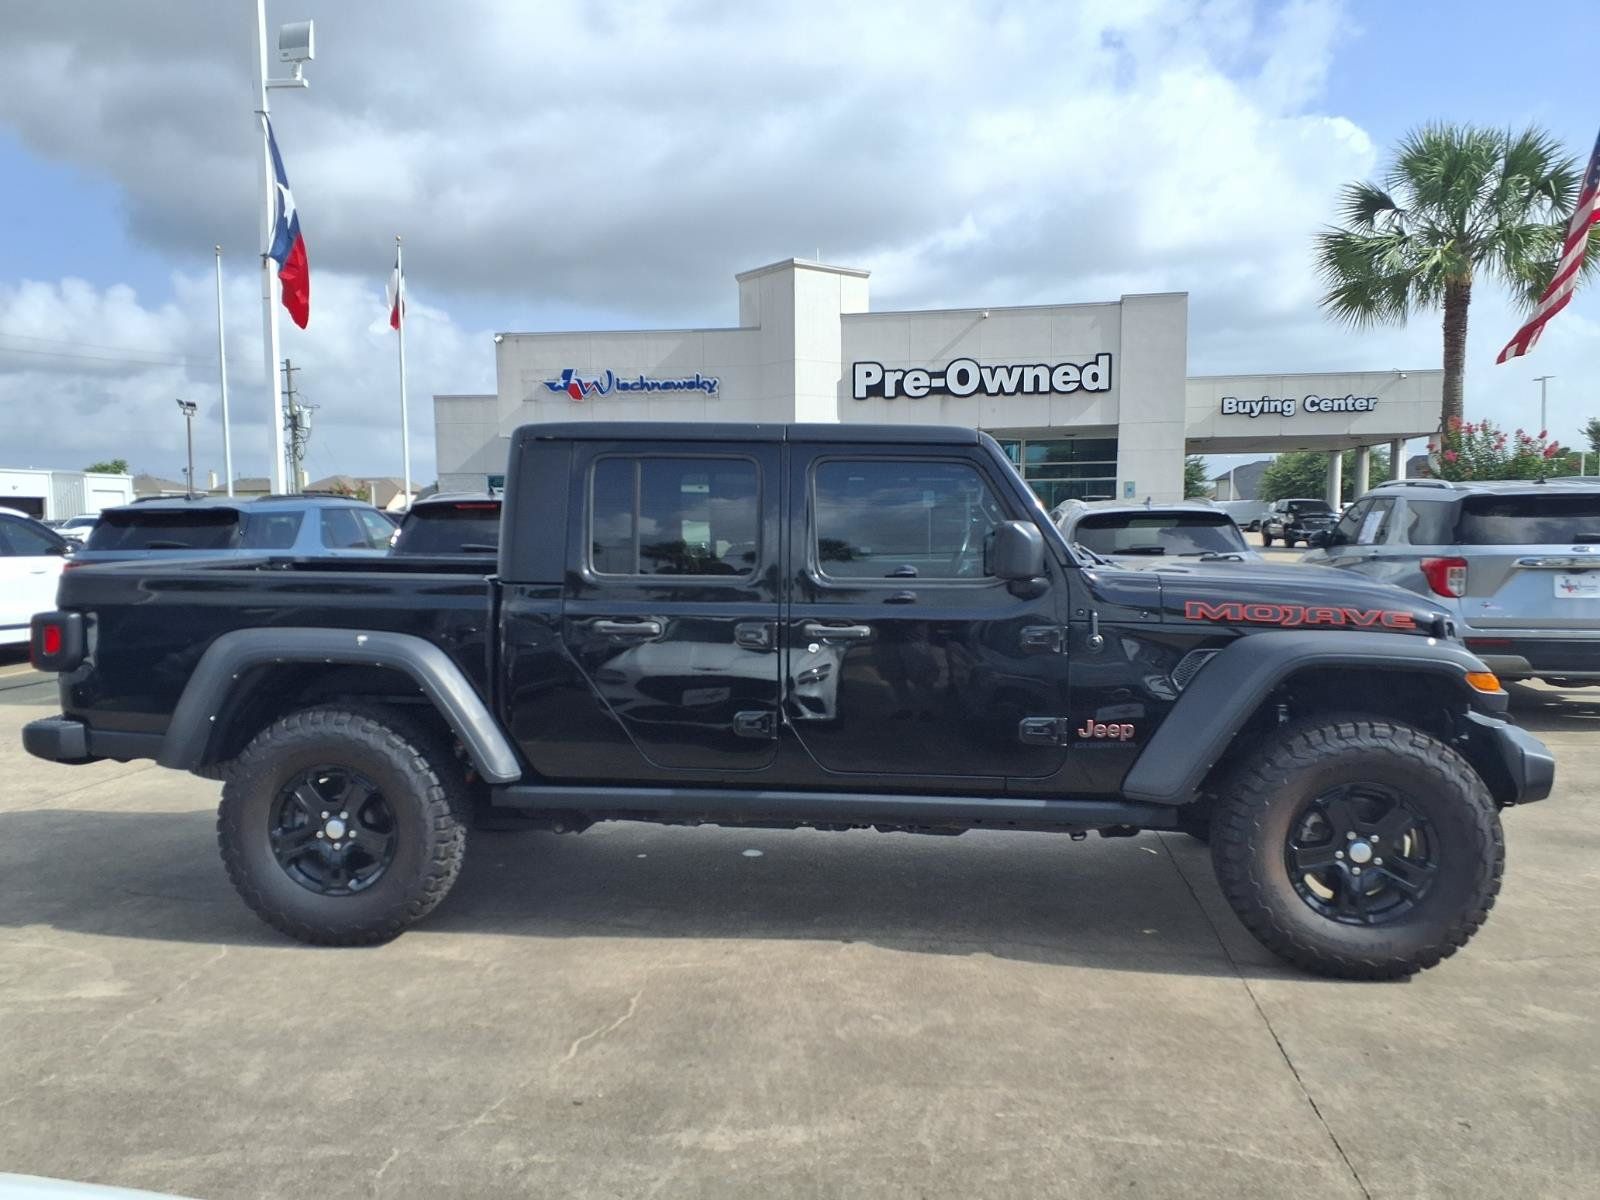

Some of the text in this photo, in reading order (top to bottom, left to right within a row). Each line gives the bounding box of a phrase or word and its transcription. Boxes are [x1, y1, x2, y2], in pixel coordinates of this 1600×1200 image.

[853, 353, 1112, 399] Pre-Owned
[1222, 395, 1378, 418] Buying Center
[1184, 601, 1417, 629] MOJAVE
[1078, 719, 1135, 741] Jeep
